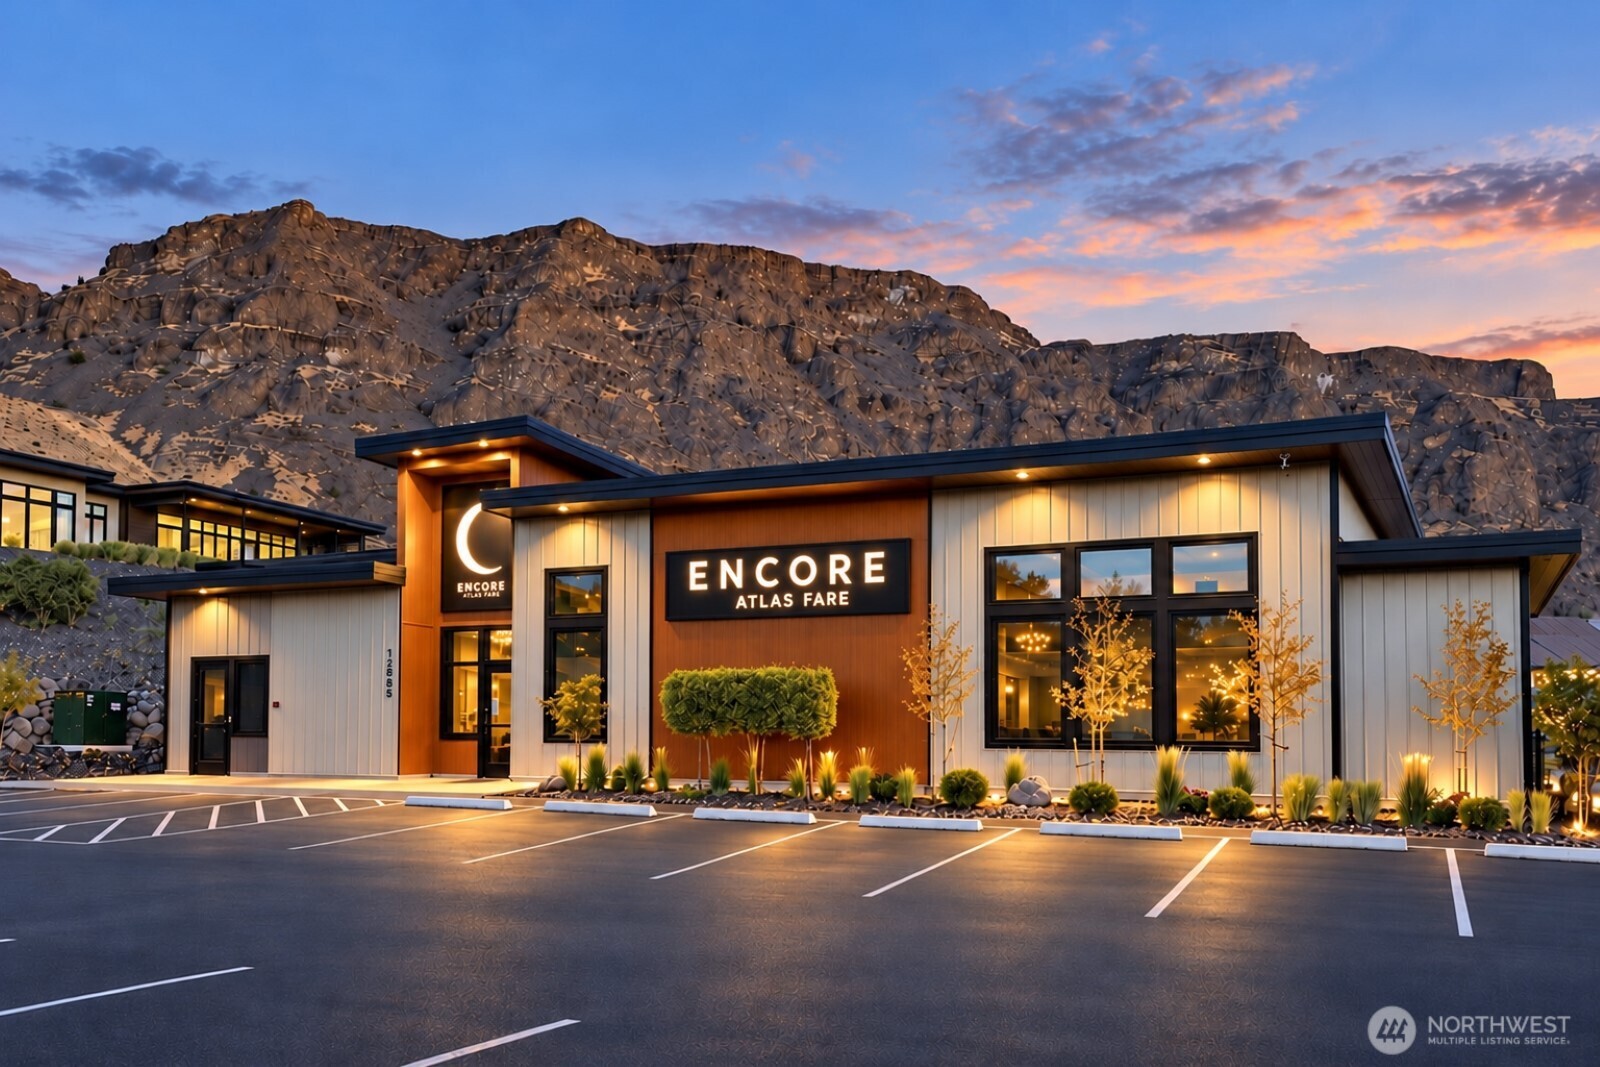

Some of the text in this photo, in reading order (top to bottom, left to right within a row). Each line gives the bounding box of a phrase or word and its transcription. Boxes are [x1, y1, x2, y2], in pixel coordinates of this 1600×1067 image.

[688, 551, 886, 592] ENCORE
[457, 580, 505, 593] ENCORE
[735, 591, 850, 610] ATLAS FARE
